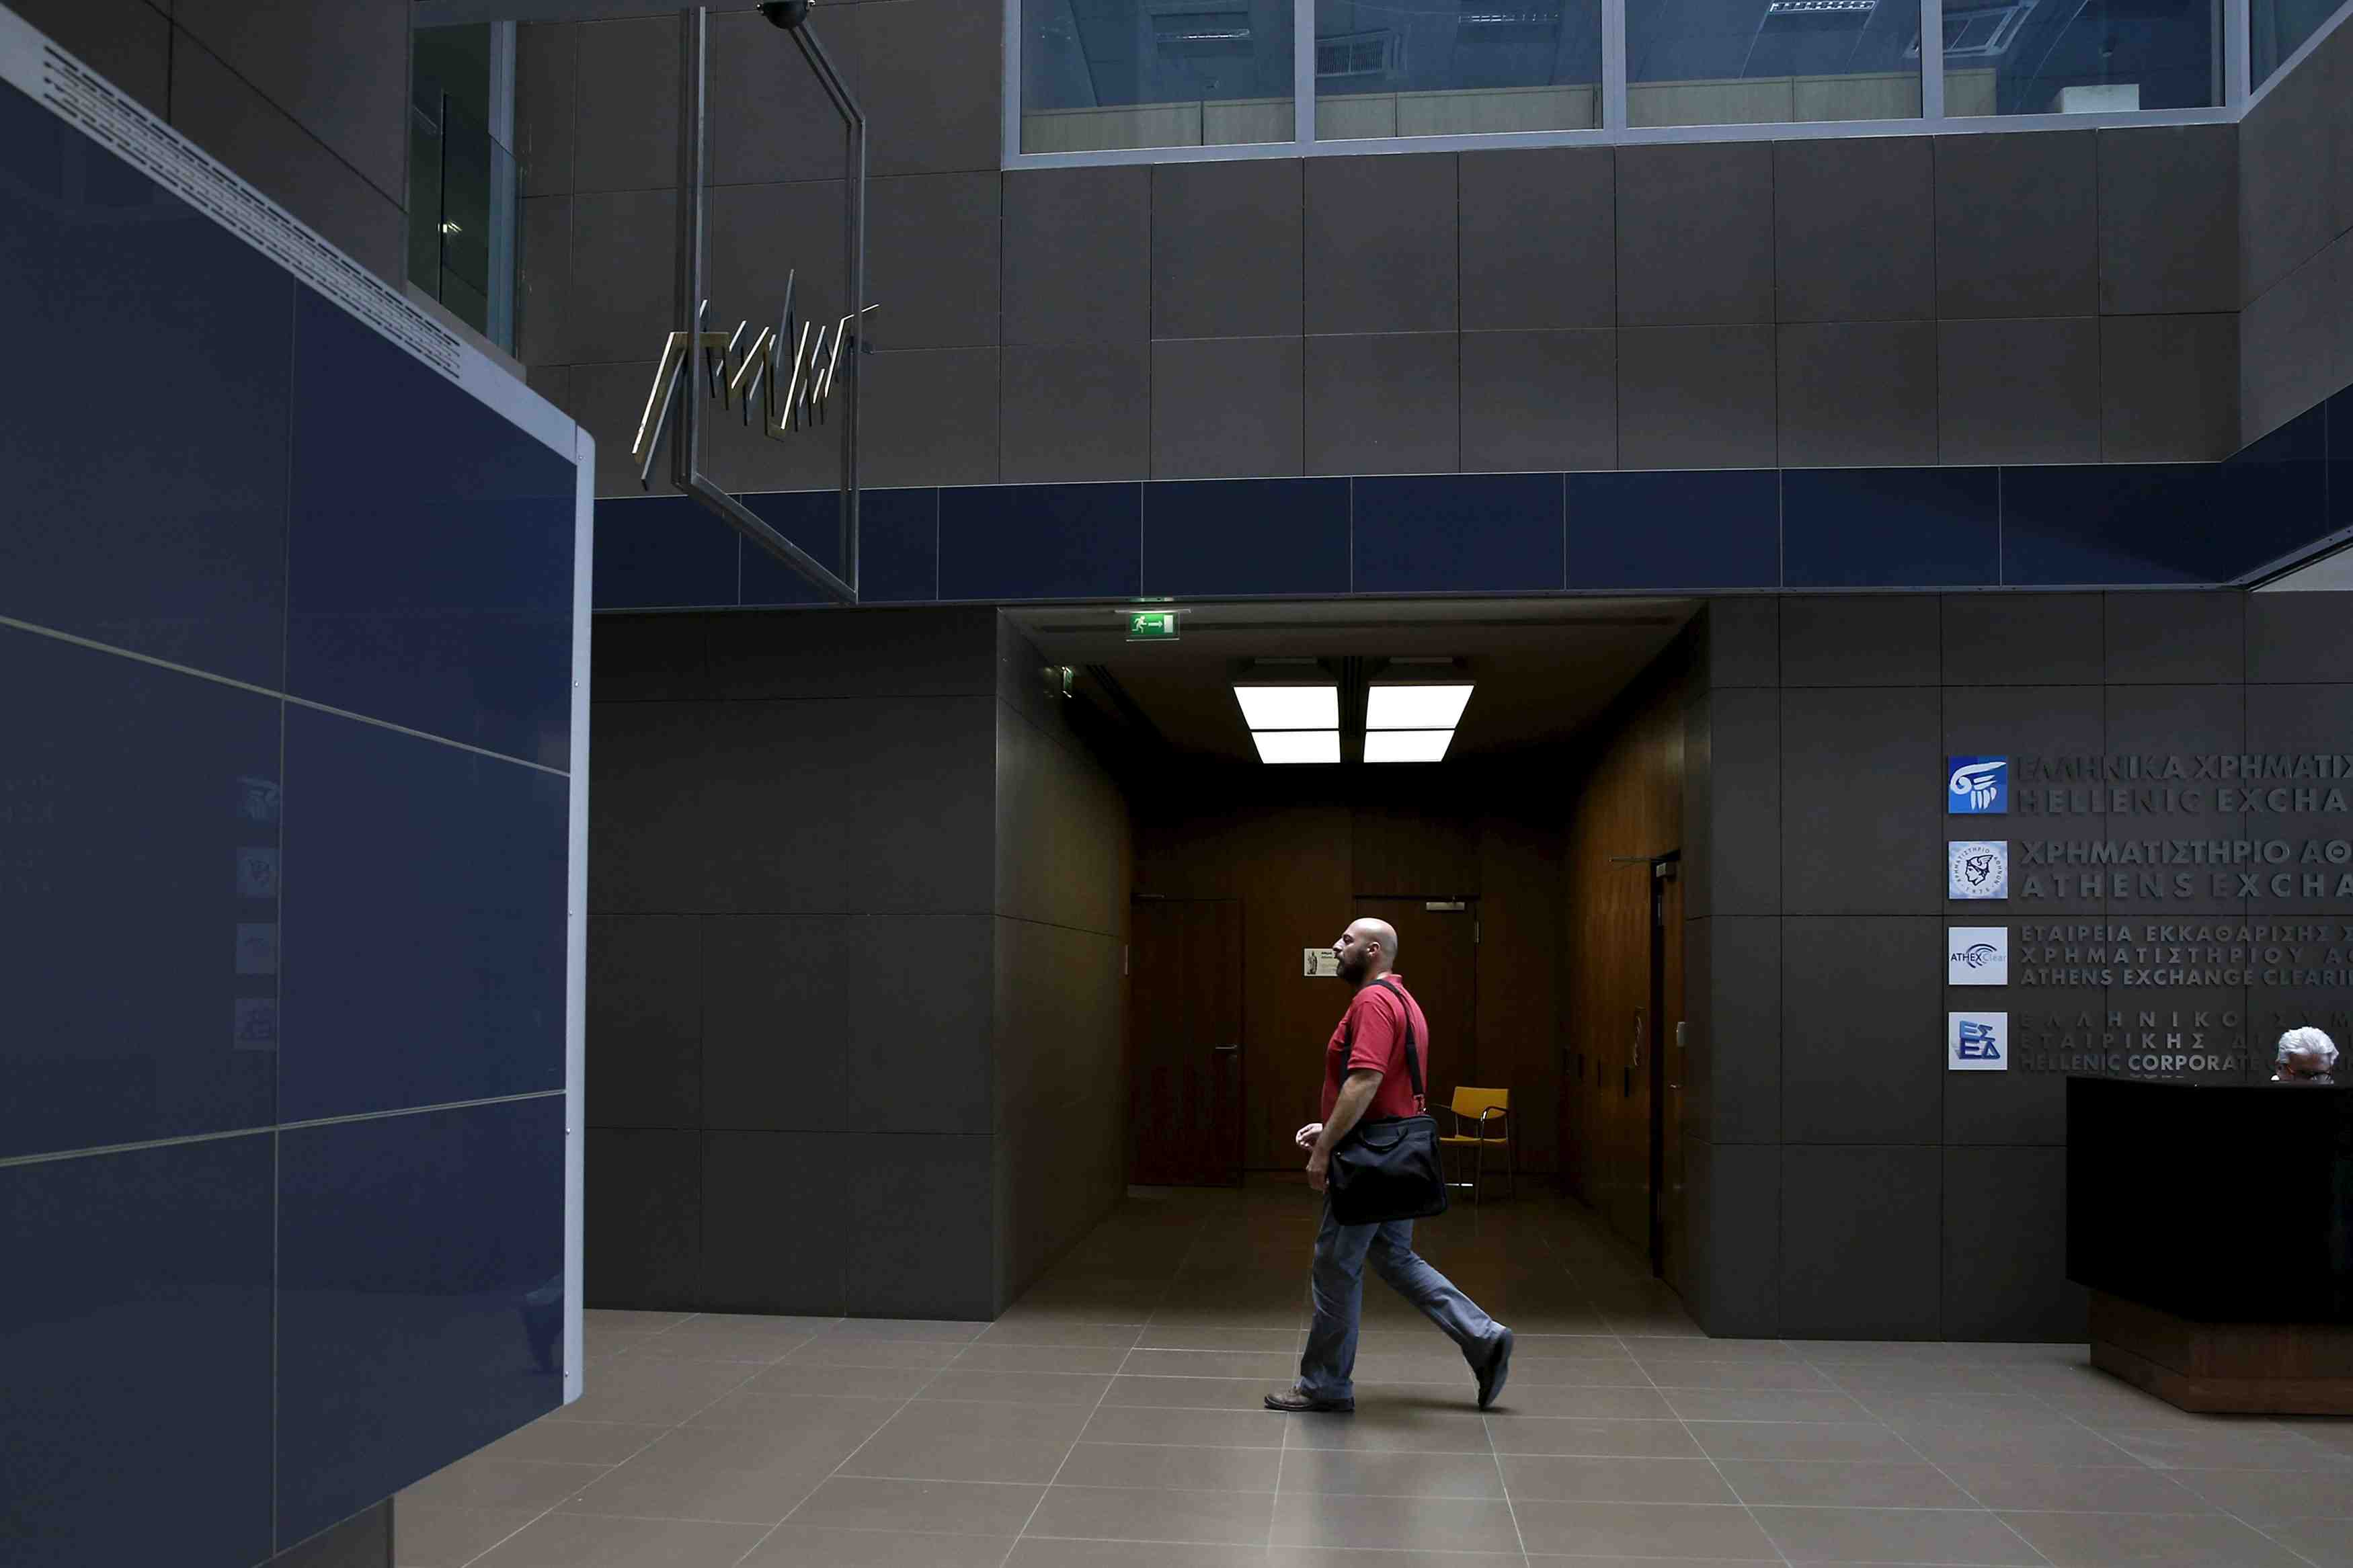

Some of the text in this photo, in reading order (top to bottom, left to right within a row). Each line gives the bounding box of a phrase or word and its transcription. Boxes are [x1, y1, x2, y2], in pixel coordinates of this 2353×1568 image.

[2018, 755, 2185, 780] ΕΛΛΗΝΙΚΑ
[2018, 788, 2348, 813] HELLENIC EXCHA
[2020, 840, 2291, 865] ΧΡΗΜΑΤΙΣΤΗΡΙΟ
[2020, 872, 2353, 899] ATHENS EXCHA
[2020, 925, 2132, 942] ΕΤΑΙΡΕΙΑ
[2145, 924, 2331, 942] ΕΚΚΑΘΑΡΙΣΗΣ
[2020, 947, 2303, 964] ΧΡΗΜΑΤΙΣΤΗΡΙΟΥ
[2020, 968, 2114, 986] ATHENS
[2122, 968, 2254, 986] EXCHANGE
[2018, 1010, 2239, 1028] ΕΛΛΗΝΙΚΟ
[2020, 1032, 2206, 1050] ΕΤΑΙΡΙΚΗΣ
[2020, 1054, 2121, 1071] HELLENIC
[2127, 1054, 2260, 1071] CORPORATE
